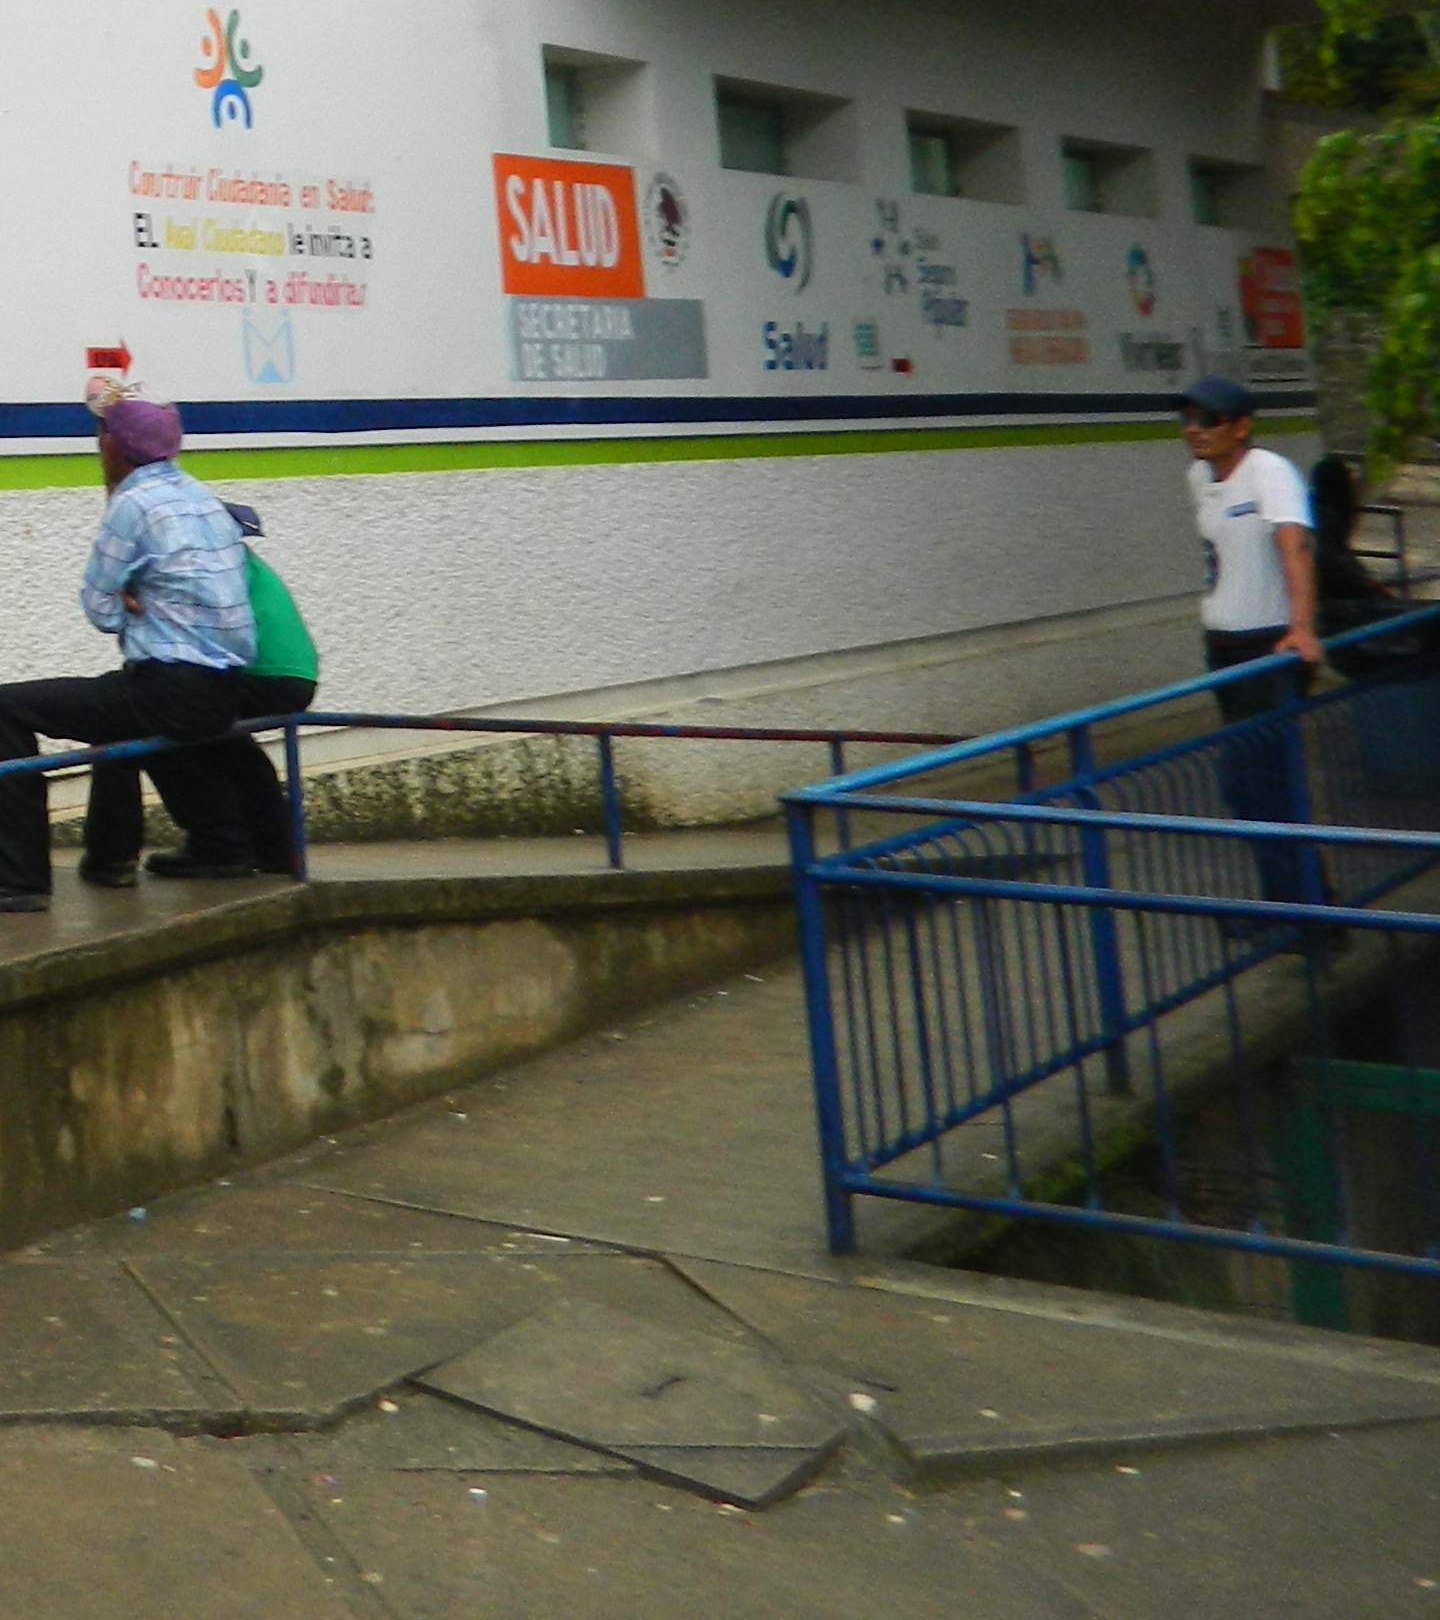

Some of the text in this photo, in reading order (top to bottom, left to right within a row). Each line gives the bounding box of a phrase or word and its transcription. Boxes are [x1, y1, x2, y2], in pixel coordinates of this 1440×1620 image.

[133, 212, 160, 249] EL
[307, 224, 357, 260] invita
[360, 236, 374, 260] a
[505, 174, 620, 269] SALUD
[266, 279, 279, 305] a
[764, 321, 829, 370] Salud
